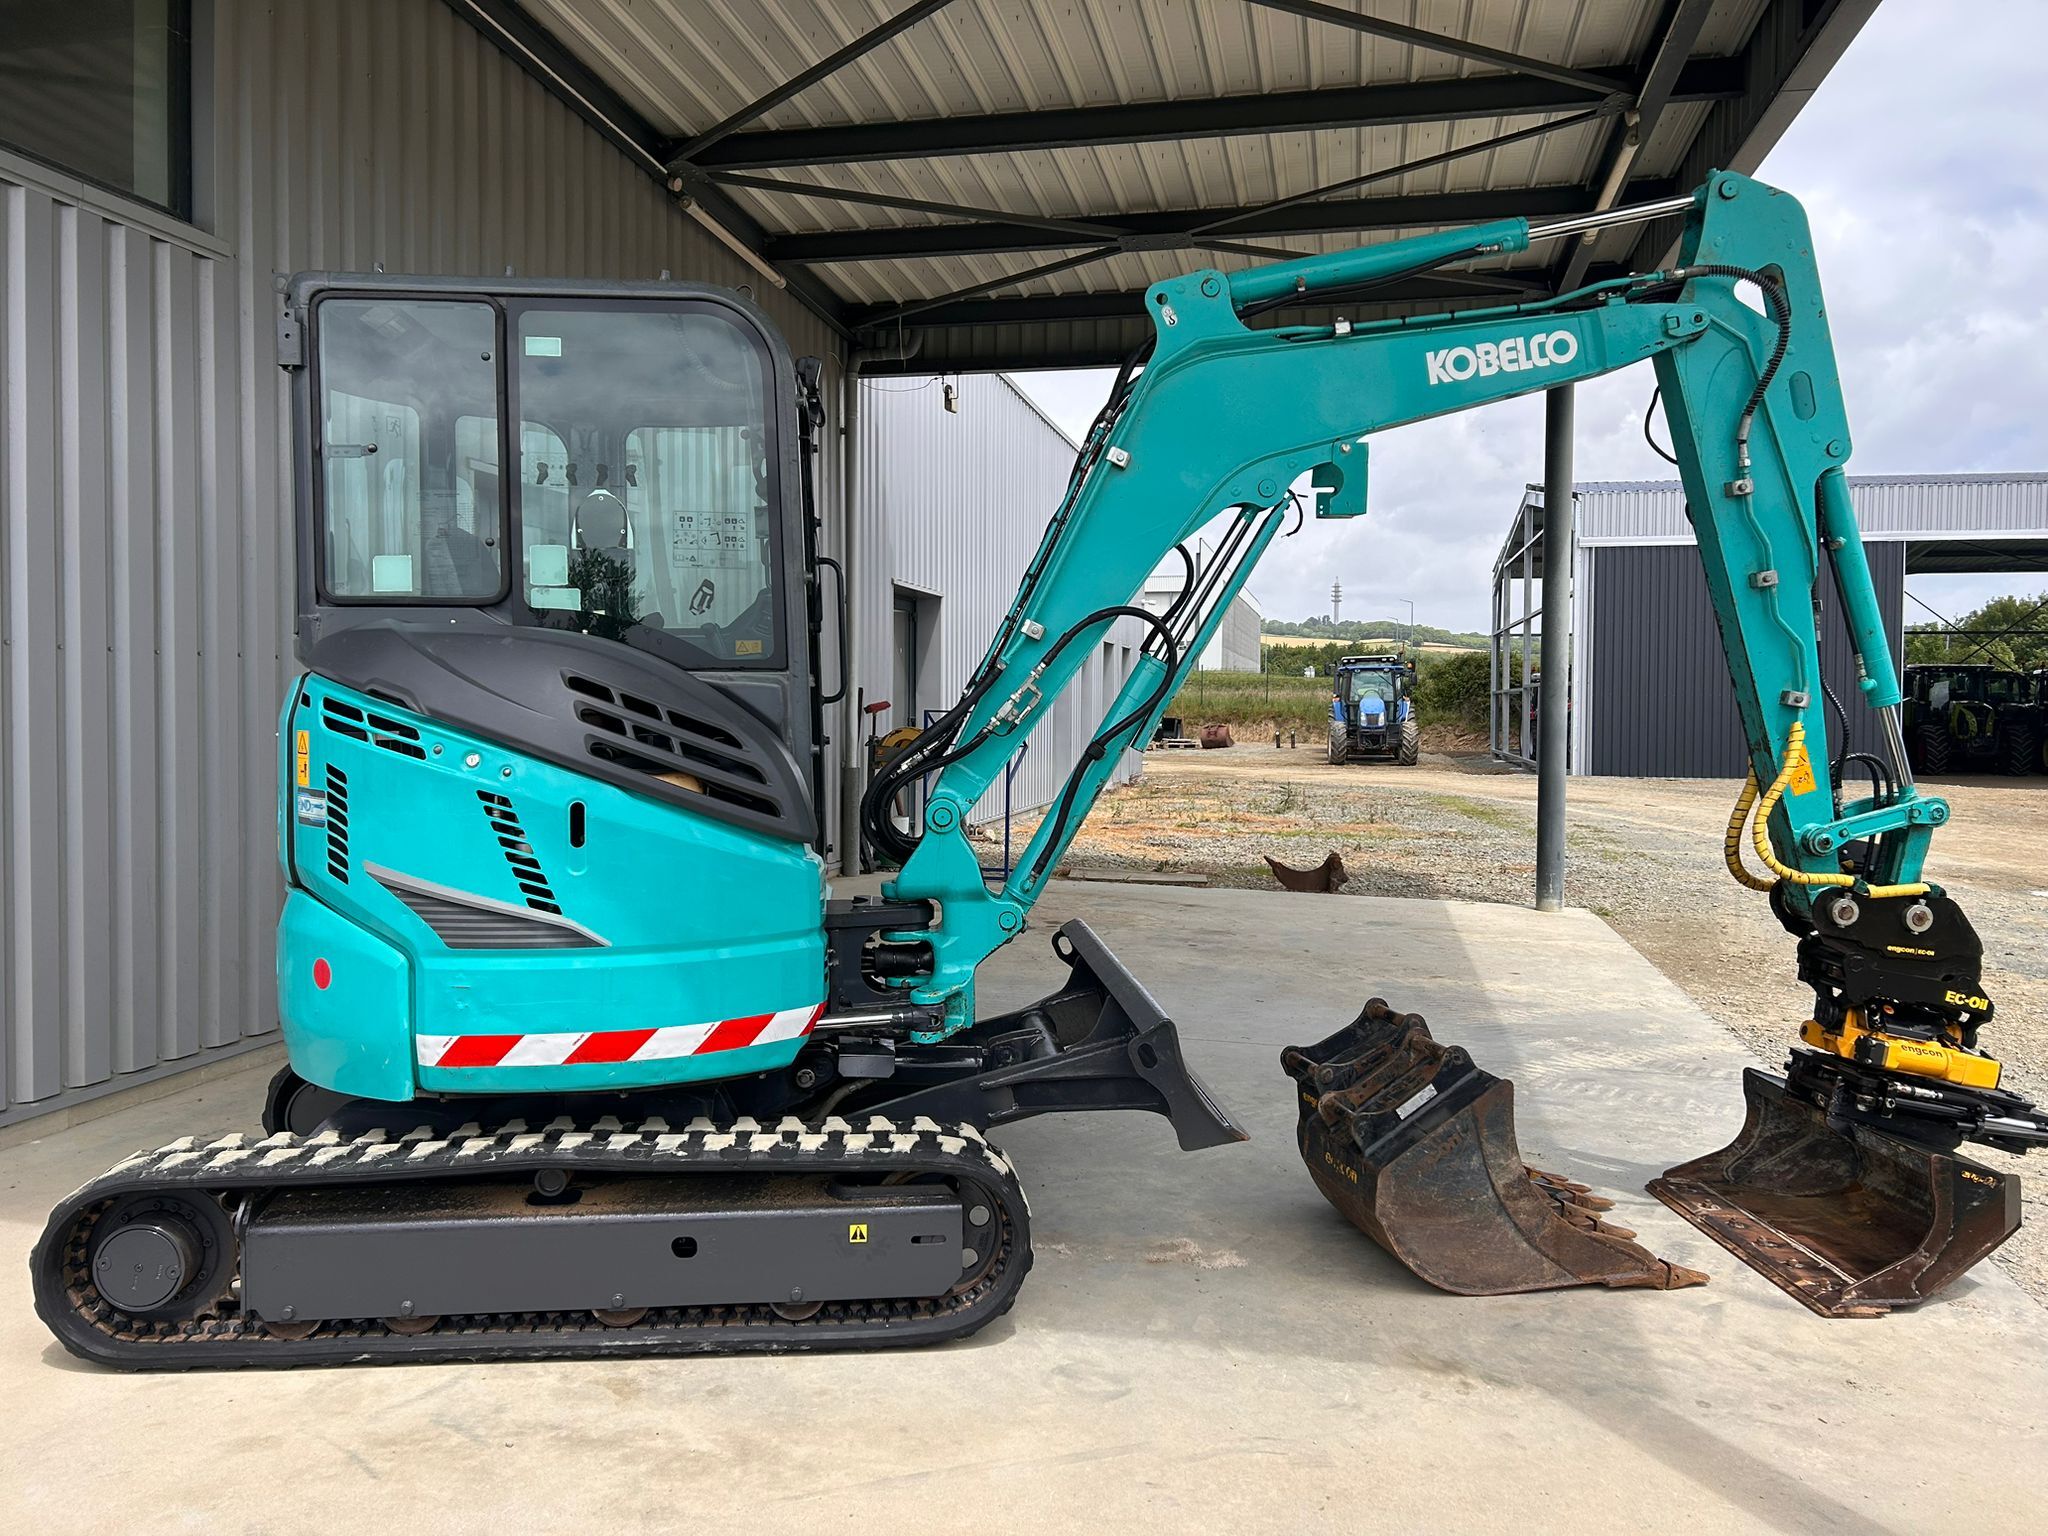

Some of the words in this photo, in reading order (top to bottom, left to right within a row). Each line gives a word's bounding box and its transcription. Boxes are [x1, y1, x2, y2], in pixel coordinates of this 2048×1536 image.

[1425, 330, 1578, 385] KOBELCO
[1944, 990, 1989, 1011] EC-Oil
[1900, 1044, 1944, 1058] engcon
